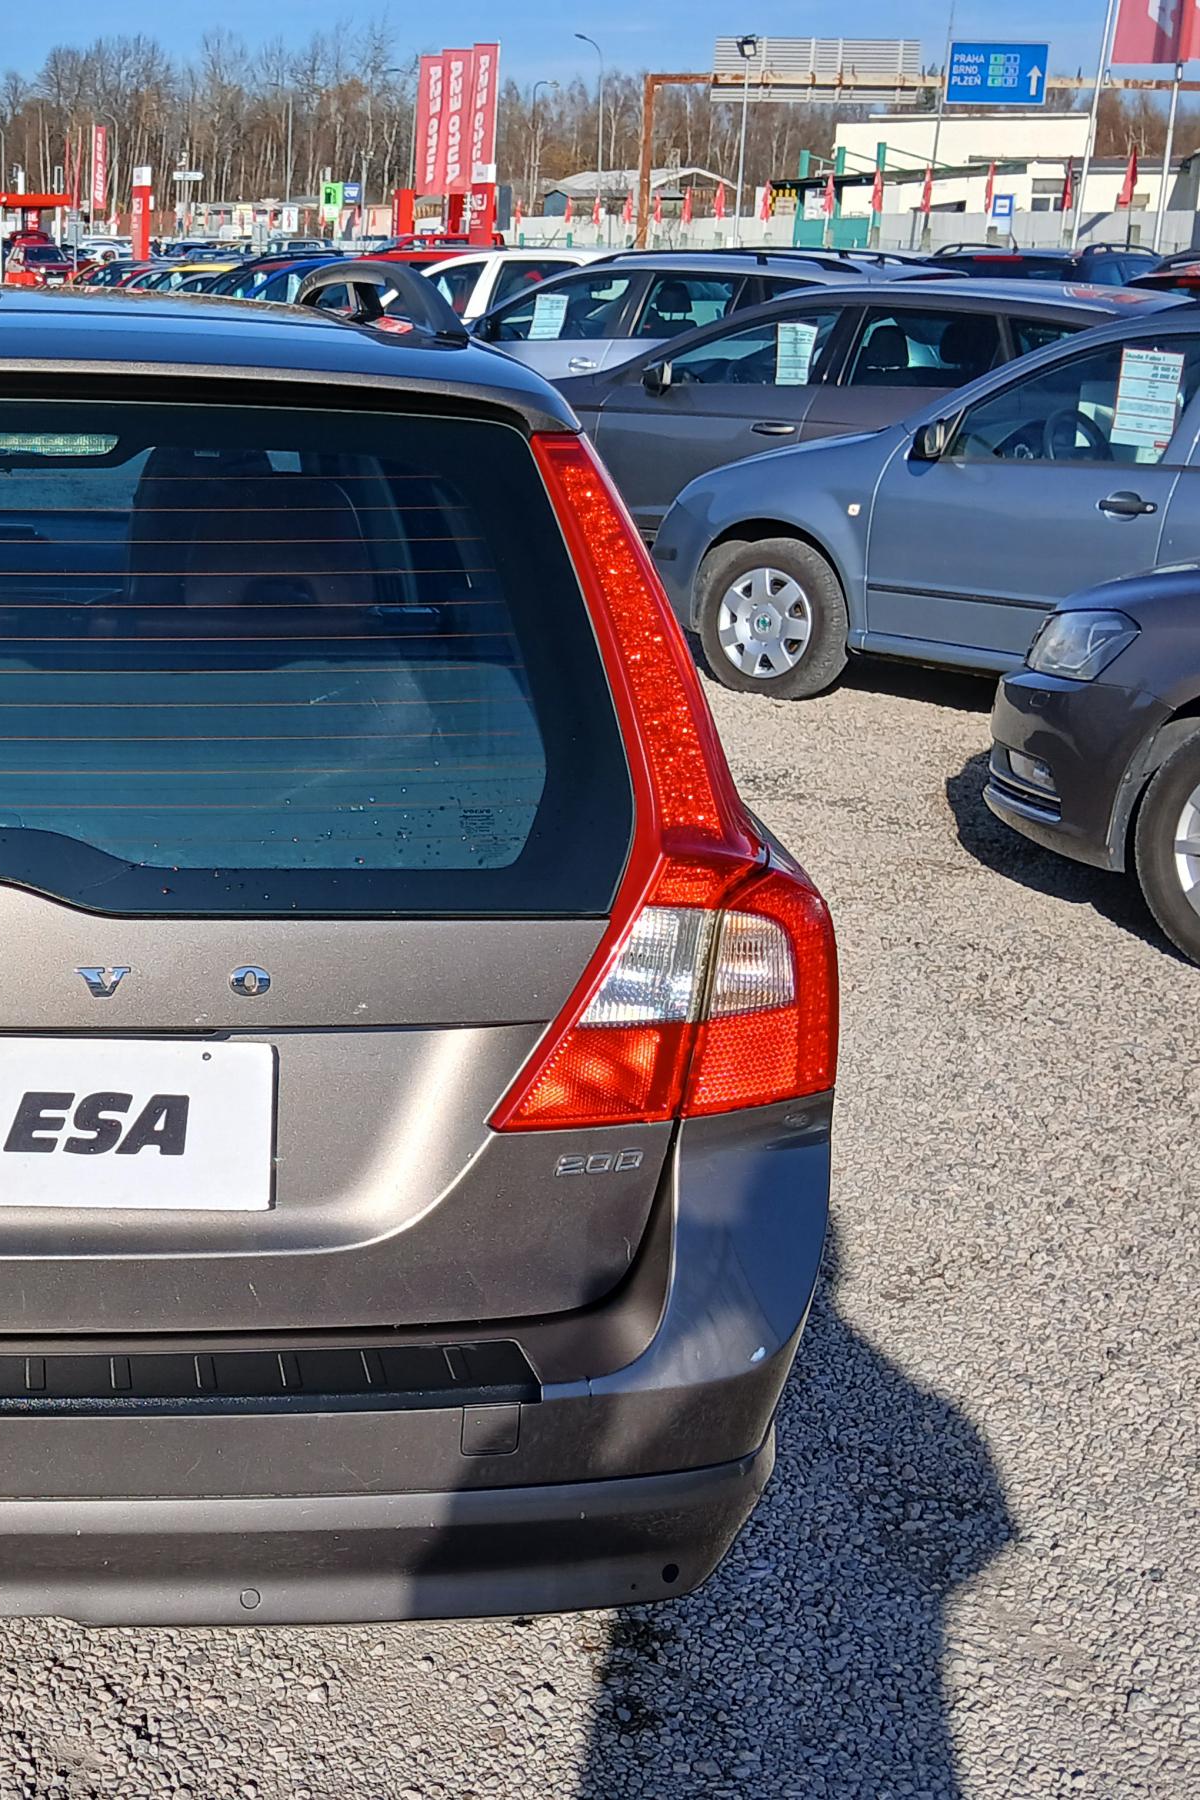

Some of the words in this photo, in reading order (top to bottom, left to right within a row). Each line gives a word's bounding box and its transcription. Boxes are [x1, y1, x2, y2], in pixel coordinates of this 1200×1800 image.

[953, 54, 985, 63] PRAHA
[952, 65, 978, 74] BRNO
[3, 1091, 190, 1156] ESA
